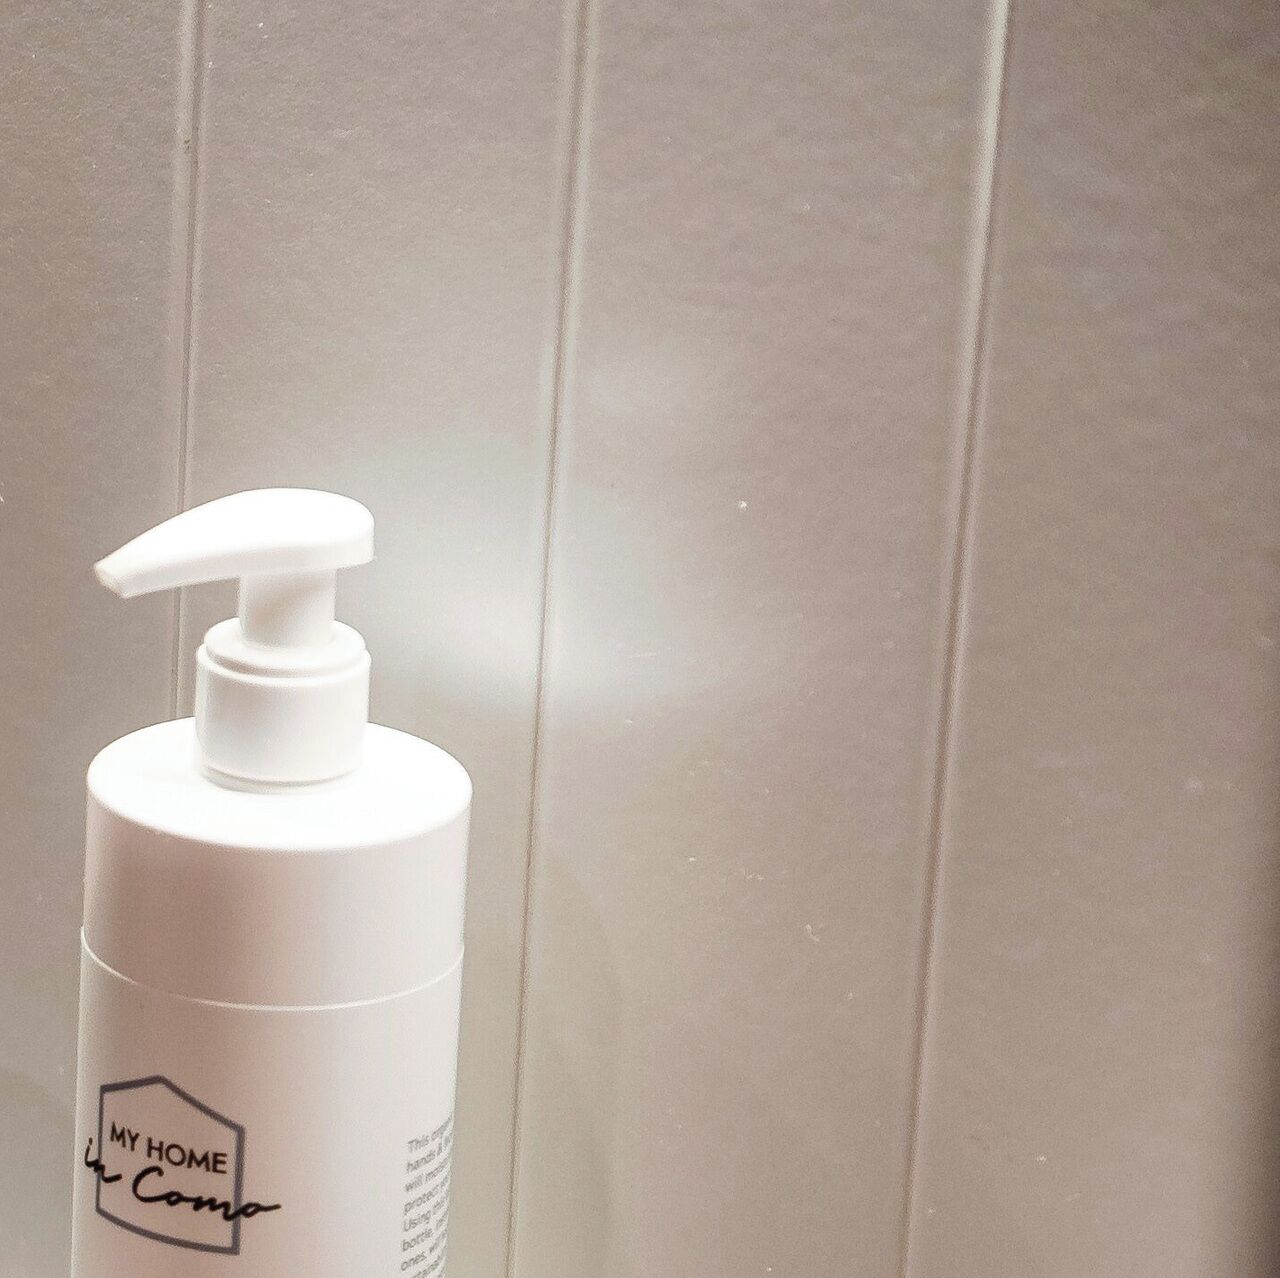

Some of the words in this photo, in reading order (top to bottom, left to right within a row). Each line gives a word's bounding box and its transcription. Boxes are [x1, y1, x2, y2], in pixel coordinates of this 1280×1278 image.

[84, 1137, 122, 1183] in
[132, 1166, 281, 1222] Como
[110, 1121, 140, 1151] MY
[147, 1137, 228, 1174] HOME
